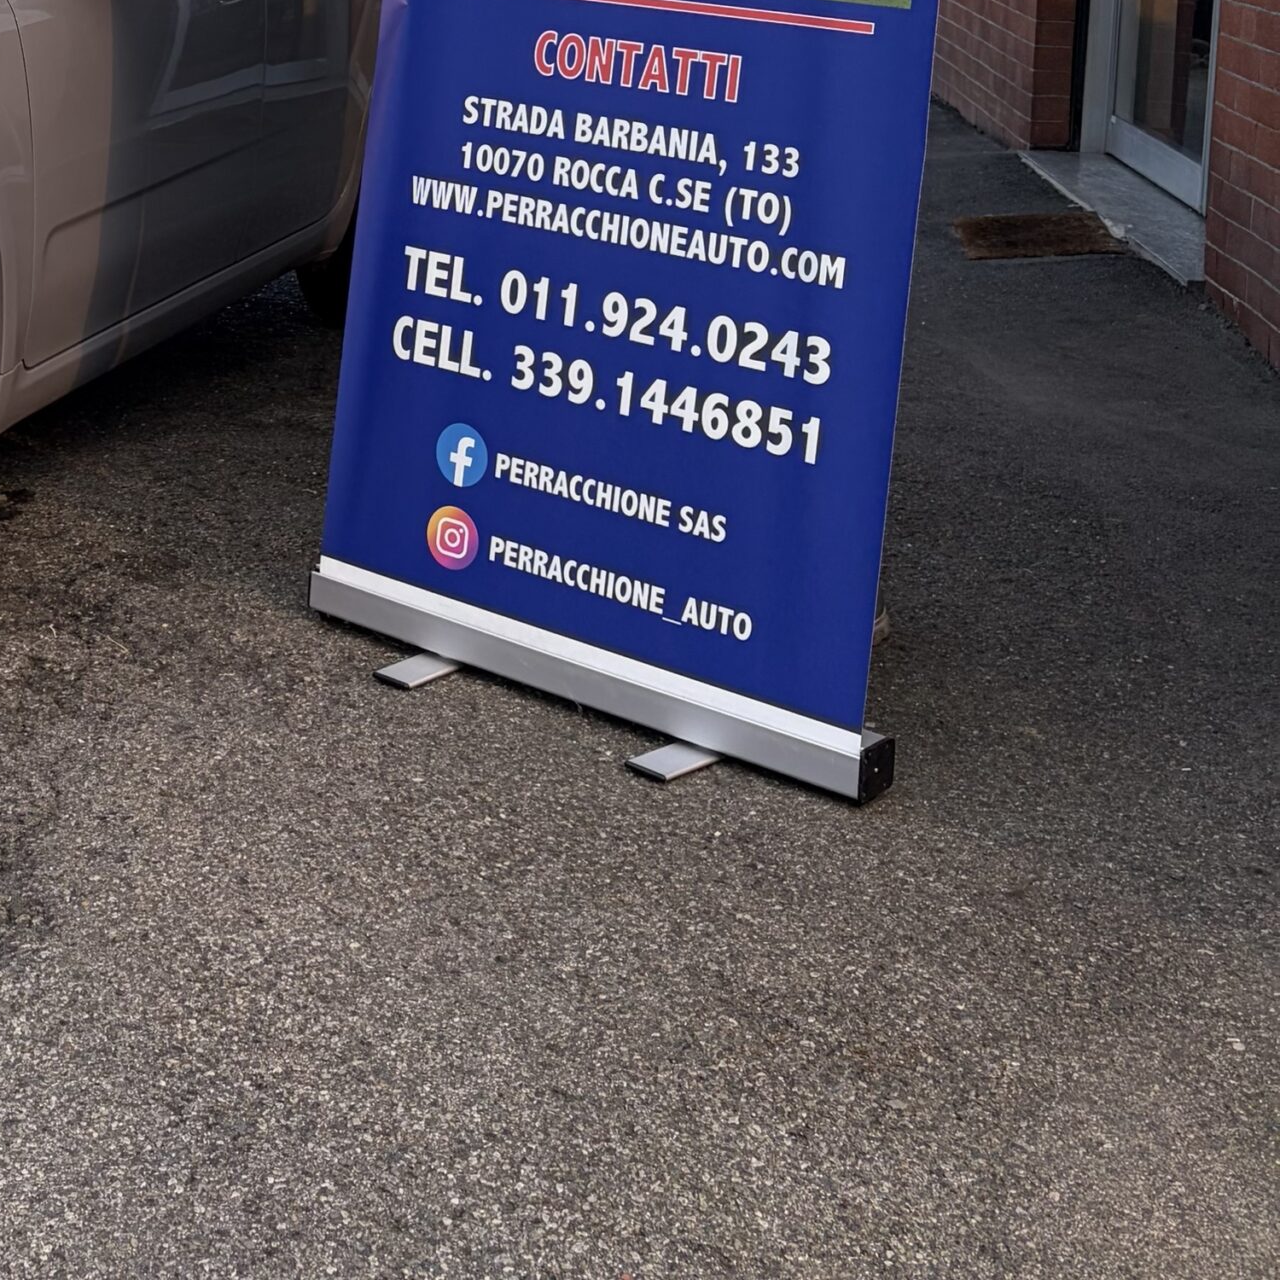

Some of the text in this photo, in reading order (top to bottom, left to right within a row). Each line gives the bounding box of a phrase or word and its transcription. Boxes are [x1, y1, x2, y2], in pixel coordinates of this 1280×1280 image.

[534, 30, 743, 103] CONTATTI
[462, 95, 800, 178] STRADA BARBANIA, 133
[411, 174, 847, 291] WWW.PERRACCHIONEAUTO.COM
[461, 141, 792, 236] 10070 ROCCA C.SE (TO)
[404, 245, 833, 387] TEL. 011.924.0243
[393, 315, 821, 465] CELL. 339.1446851
[494, 452, 727, 543] PERRACCHIONE SAS
[489, 535, 752, 641] PERRACCHIONE_AUTO
